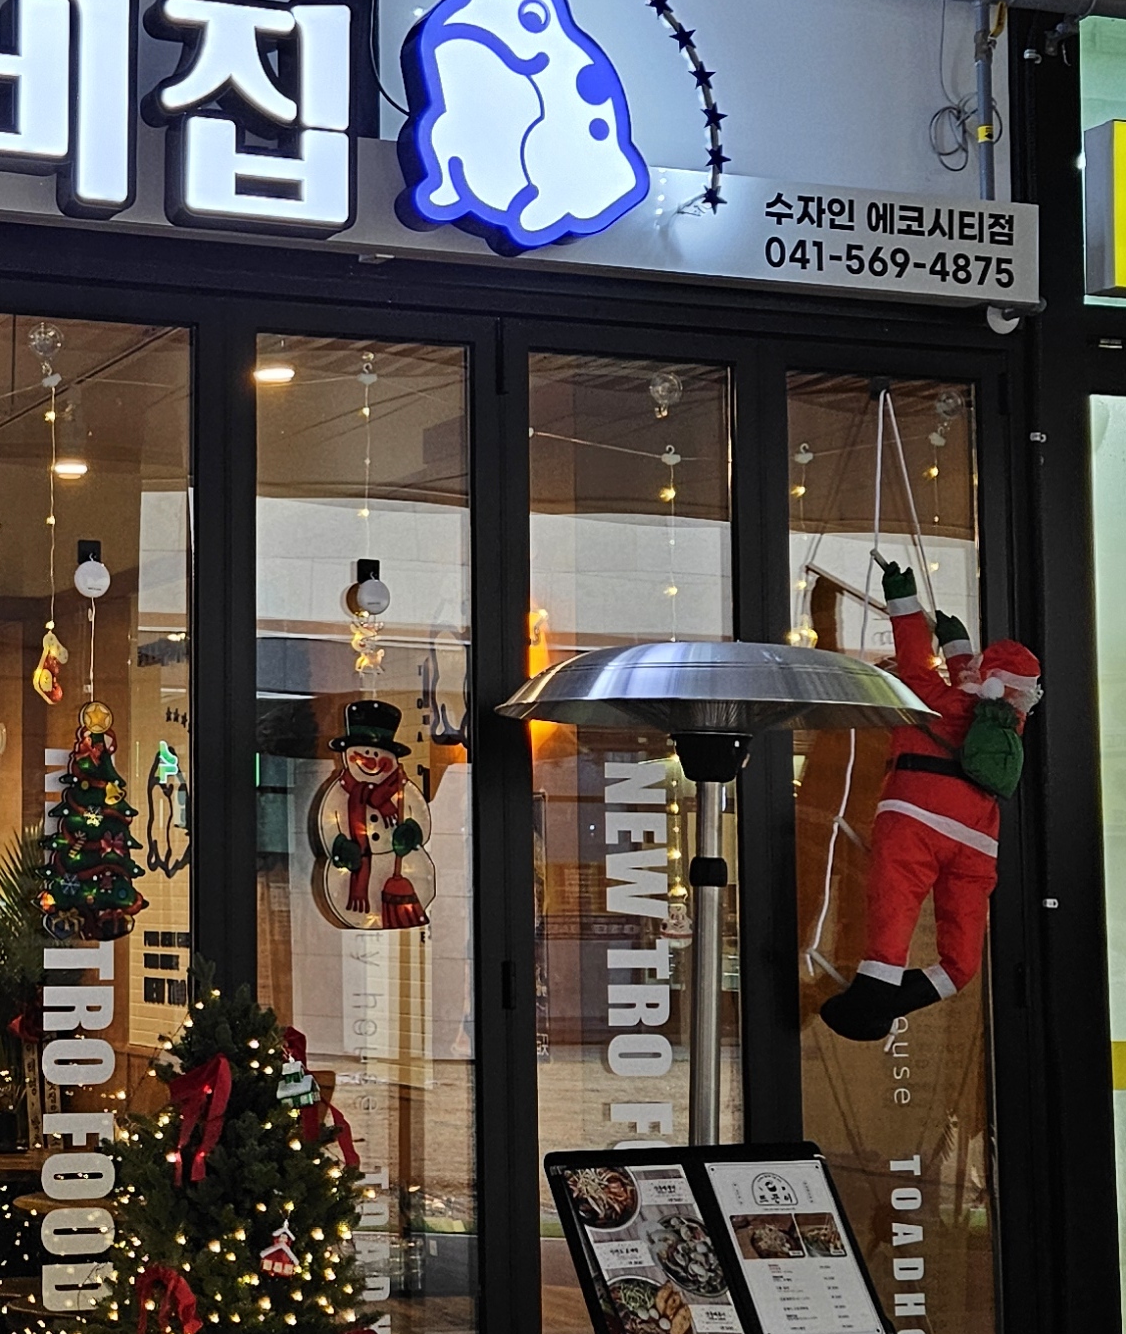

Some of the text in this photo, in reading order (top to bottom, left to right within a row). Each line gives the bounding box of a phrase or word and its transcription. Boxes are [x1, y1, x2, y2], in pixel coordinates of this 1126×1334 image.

[764, 191, 1015, 247] 수자인 에코시티점
[764, 235, 1015, 289] 041-569-4875
[890, 1014, 911, 1107] ouse
